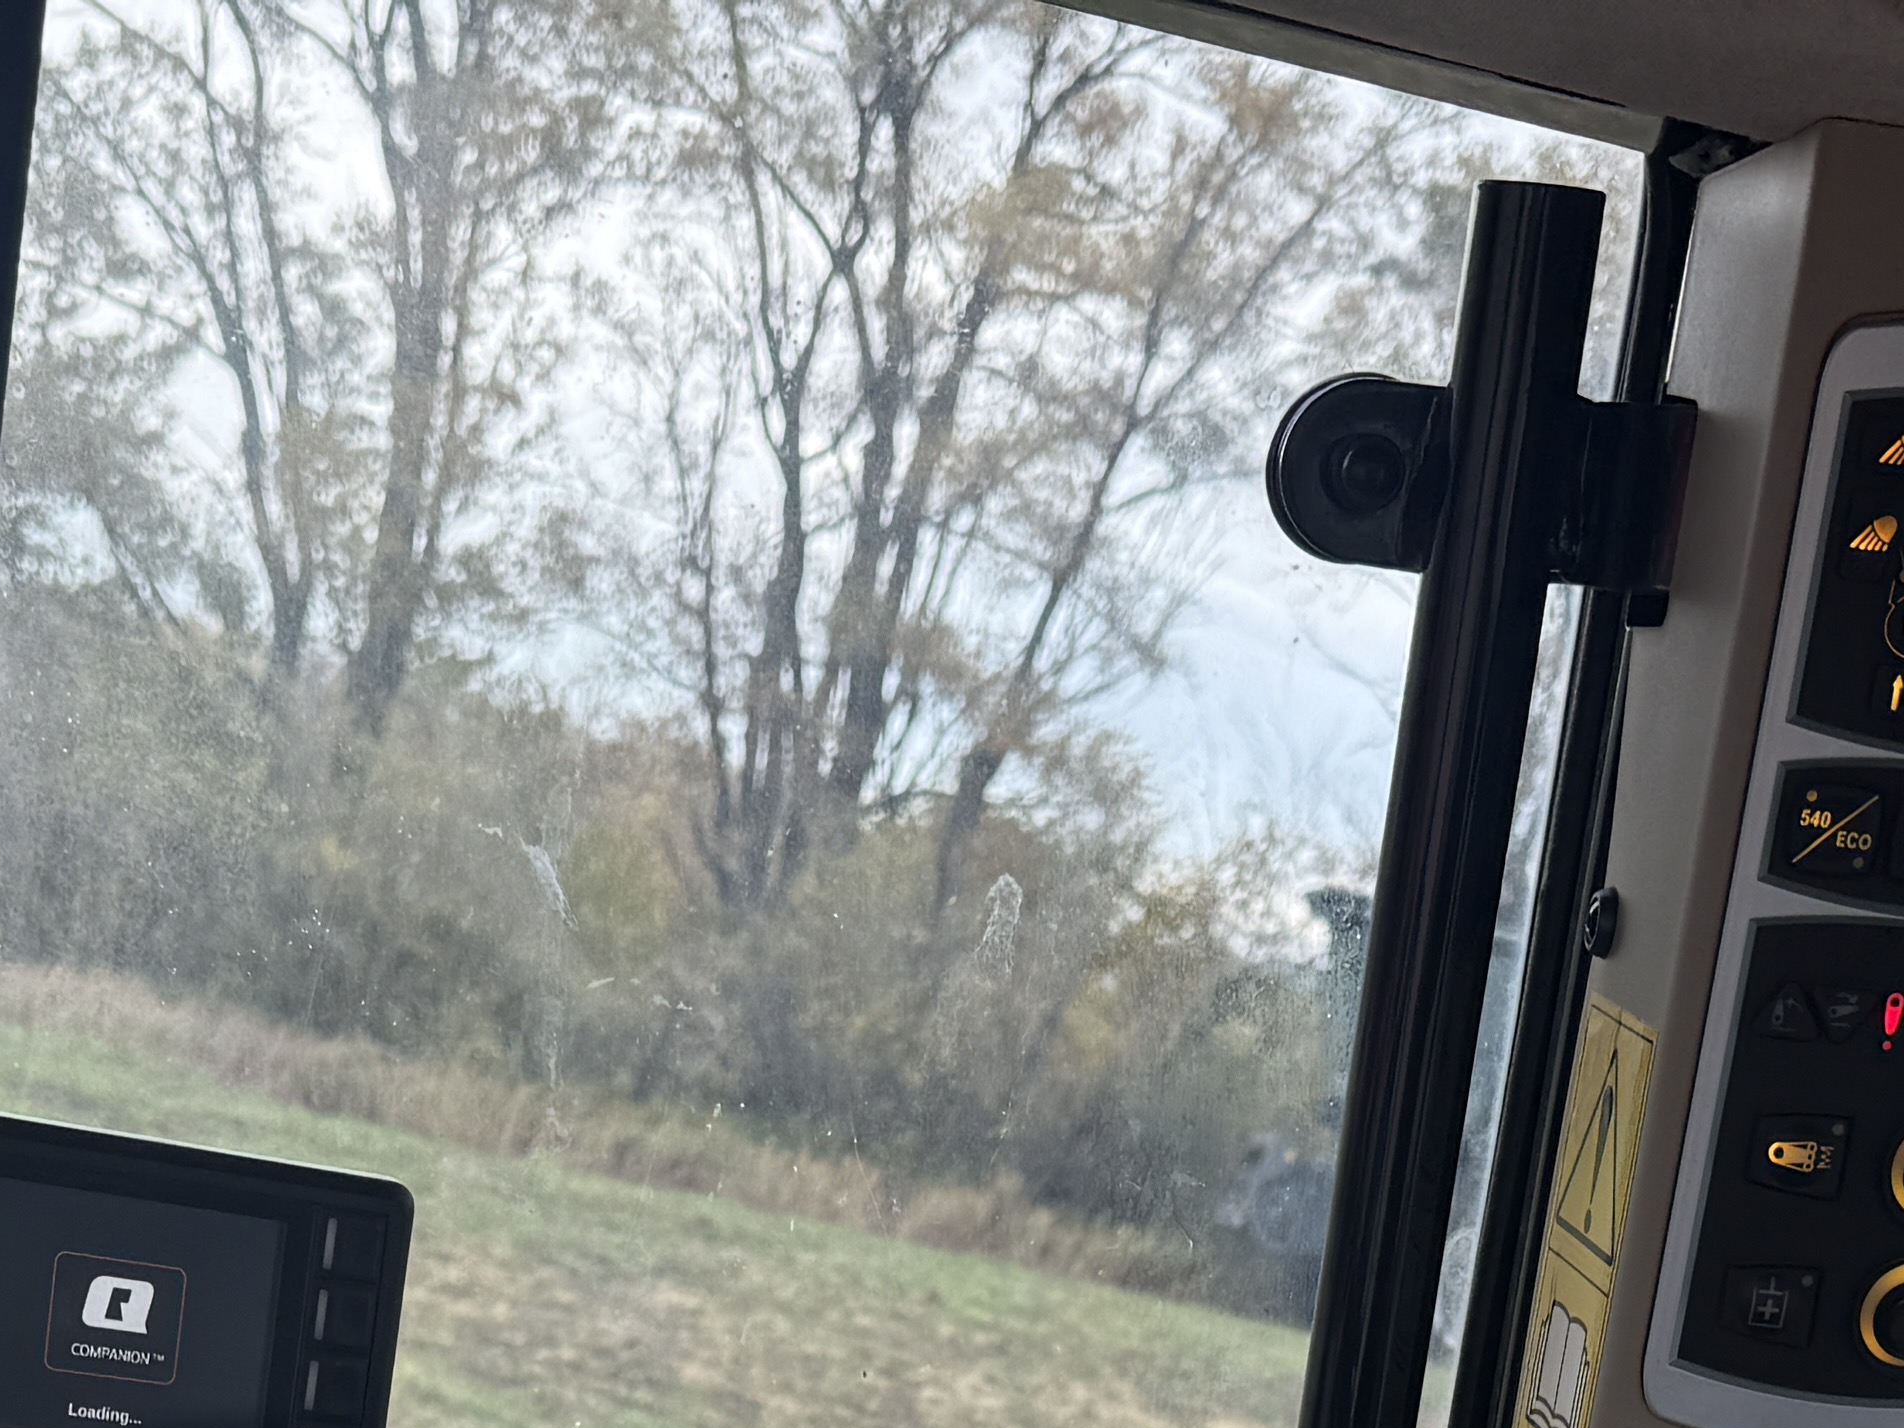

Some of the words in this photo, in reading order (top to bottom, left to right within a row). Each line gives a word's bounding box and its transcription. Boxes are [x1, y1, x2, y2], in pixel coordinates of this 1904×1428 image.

[1799, 808, 1832, 828] 540
[1835, 830, 1873, 850] ECO
[68, 1402, 142, 1426] Loading...
